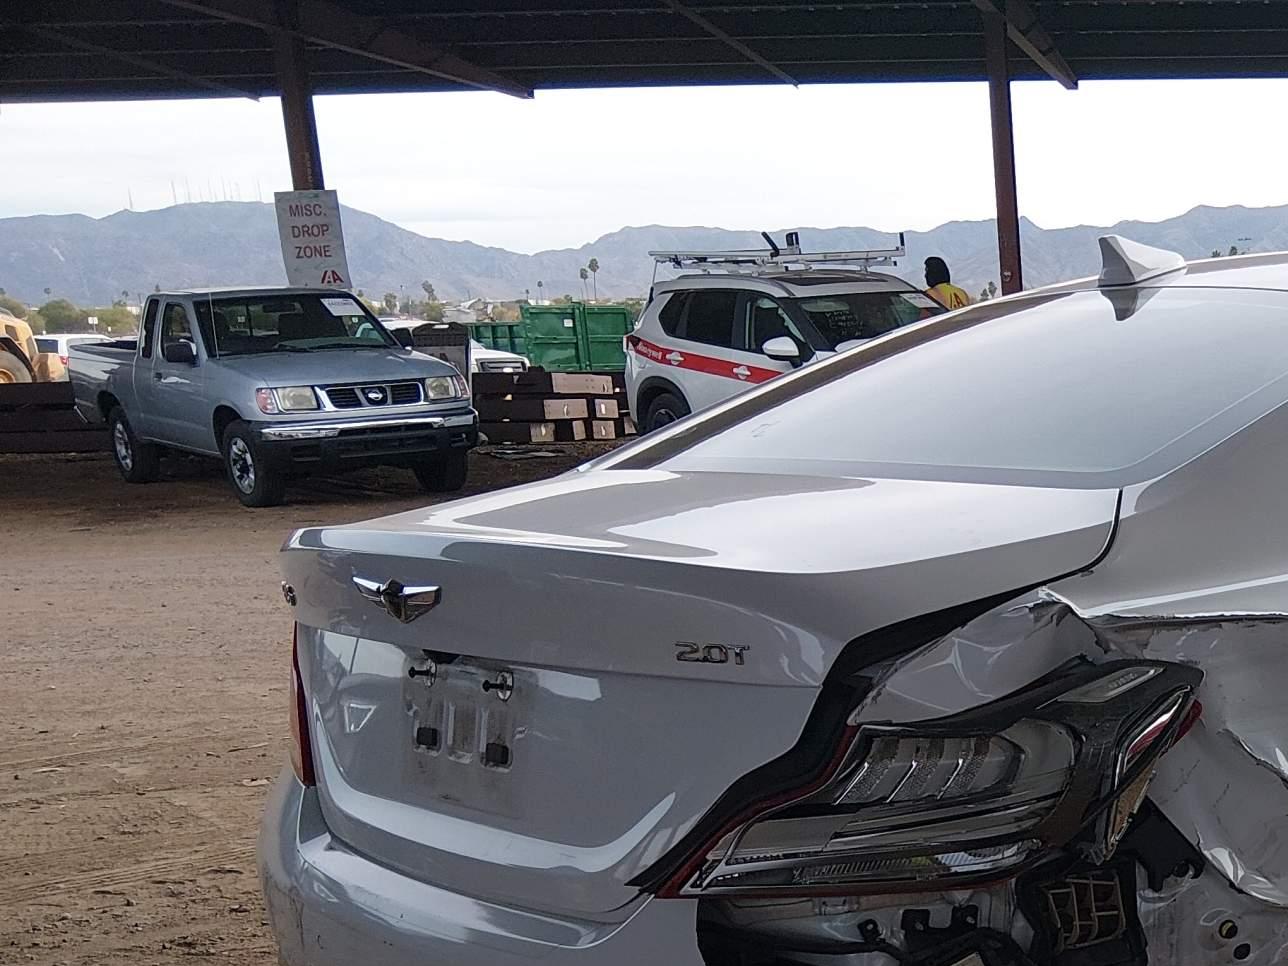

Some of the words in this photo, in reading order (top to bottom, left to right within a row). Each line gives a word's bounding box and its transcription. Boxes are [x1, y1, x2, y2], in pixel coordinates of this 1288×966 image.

[289, 203, 327, 217] MISC.
[291, 224, 329, 238] DROP
[294, 245, 332, 259] ZONE
[675, 641, 750, 666] 2.0T
